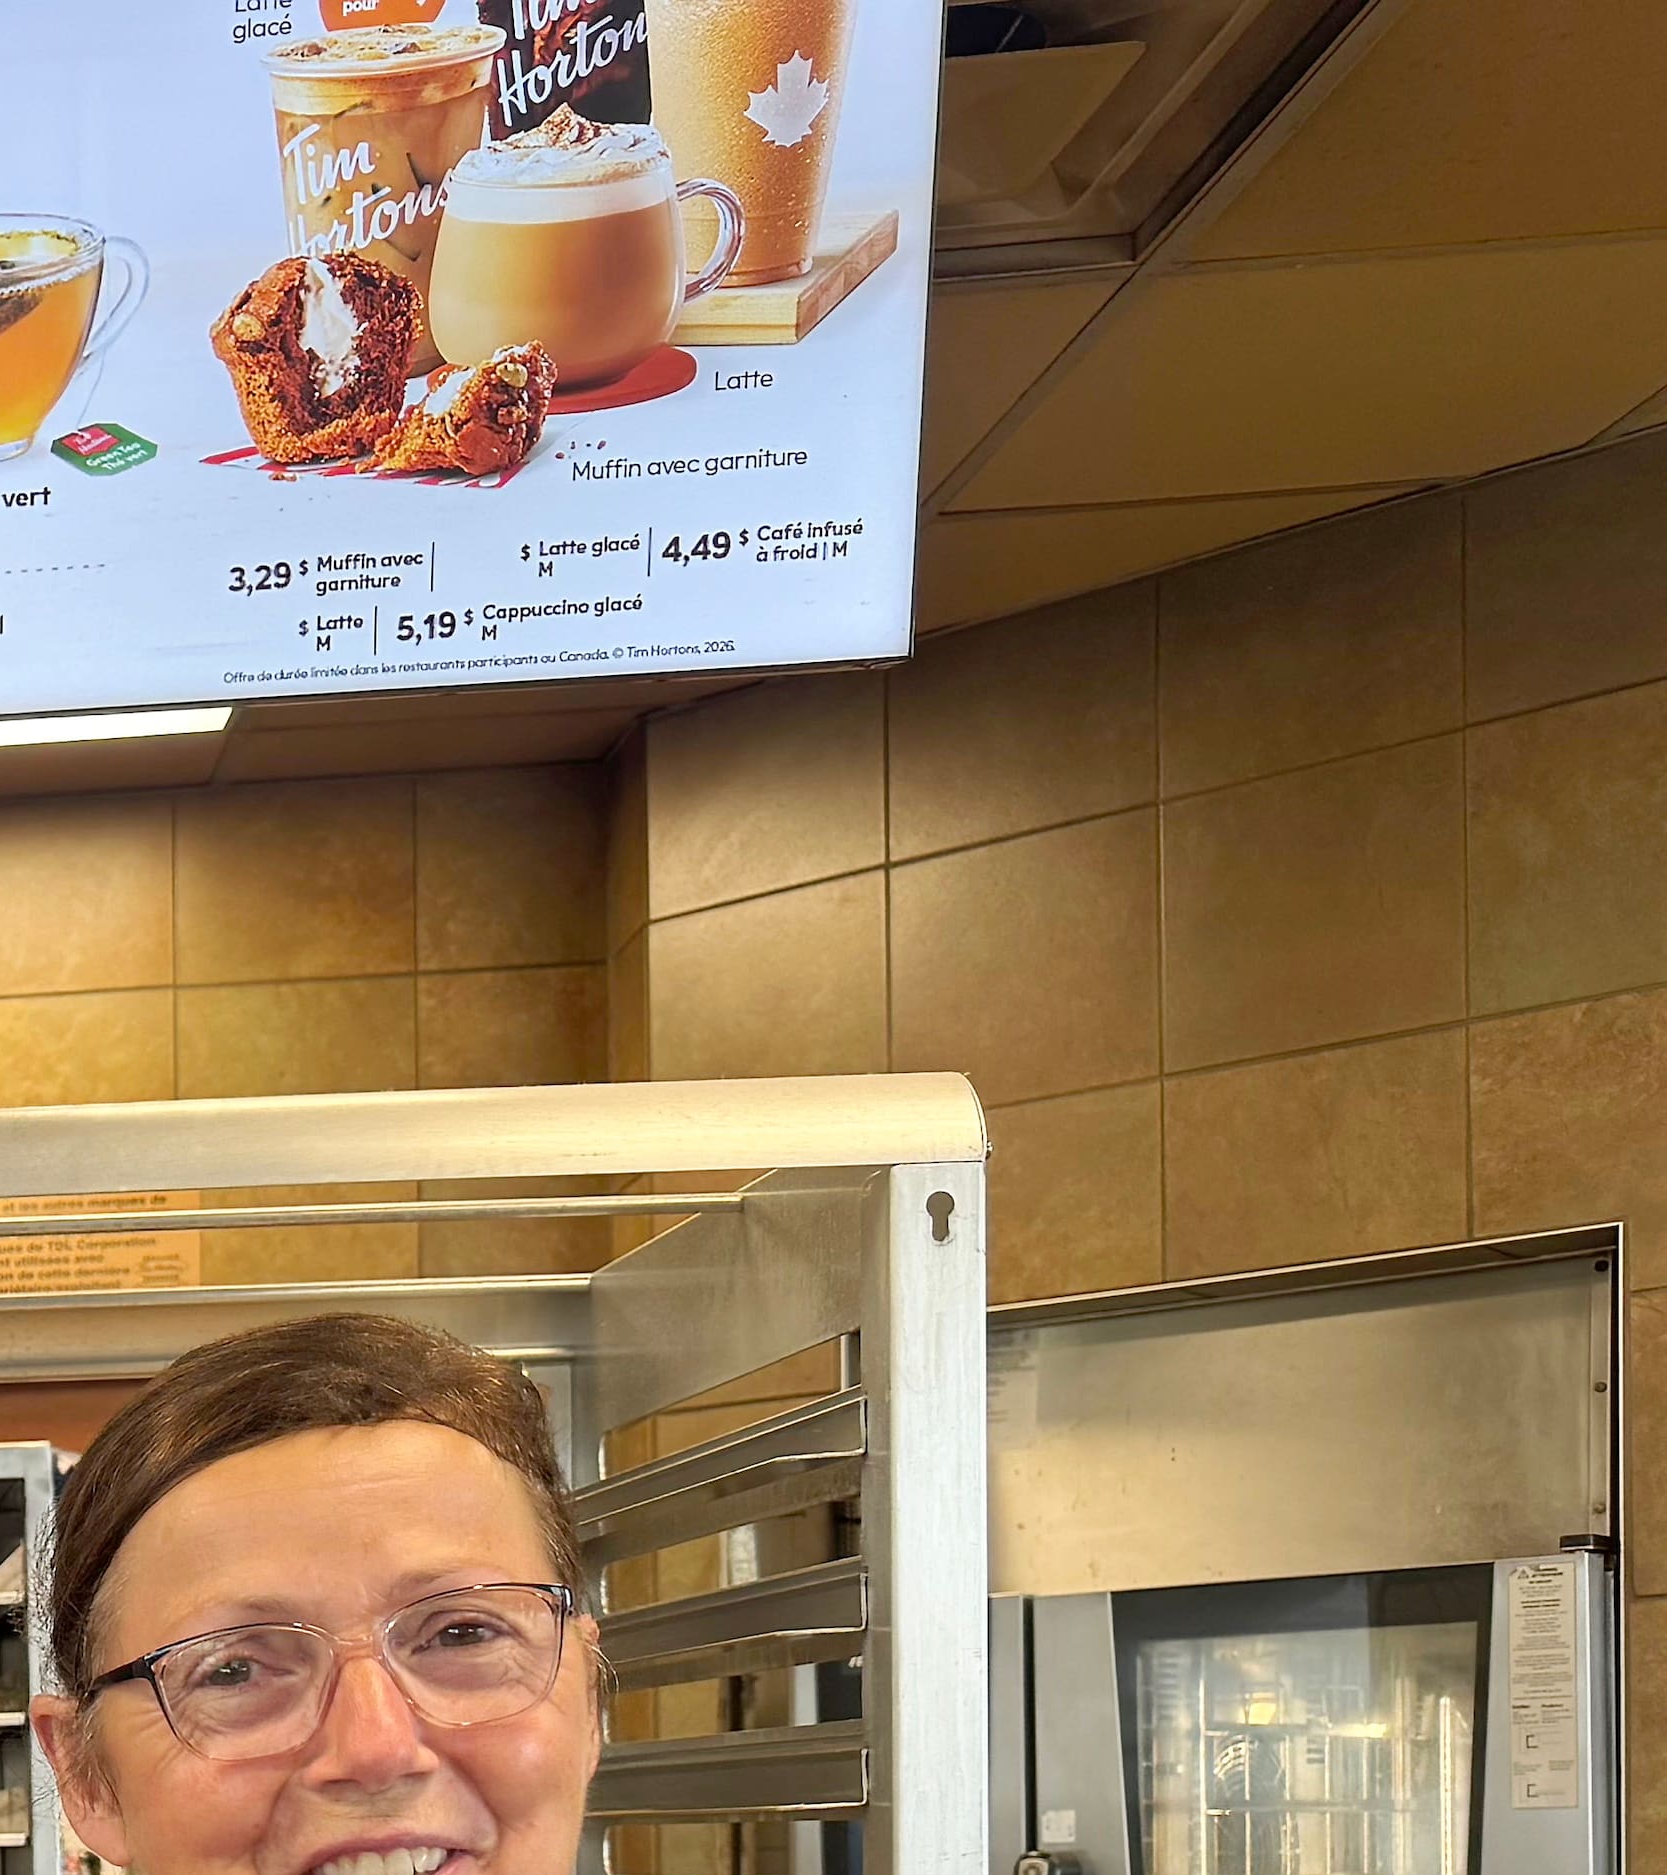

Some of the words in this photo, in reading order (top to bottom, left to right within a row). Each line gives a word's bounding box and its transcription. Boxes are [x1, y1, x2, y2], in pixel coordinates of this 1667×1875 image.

[232, 13, 292, 44] glacé
[1, 486, 52, 508] vert
[661, 531, 731, 568] 4,49
[228, 561, 292, 597] 3,29
[482, 599, 589, 624] Cappuccino
[593, 596, 643, 618] glacé
[396, 611, 457, 647] 5,19
